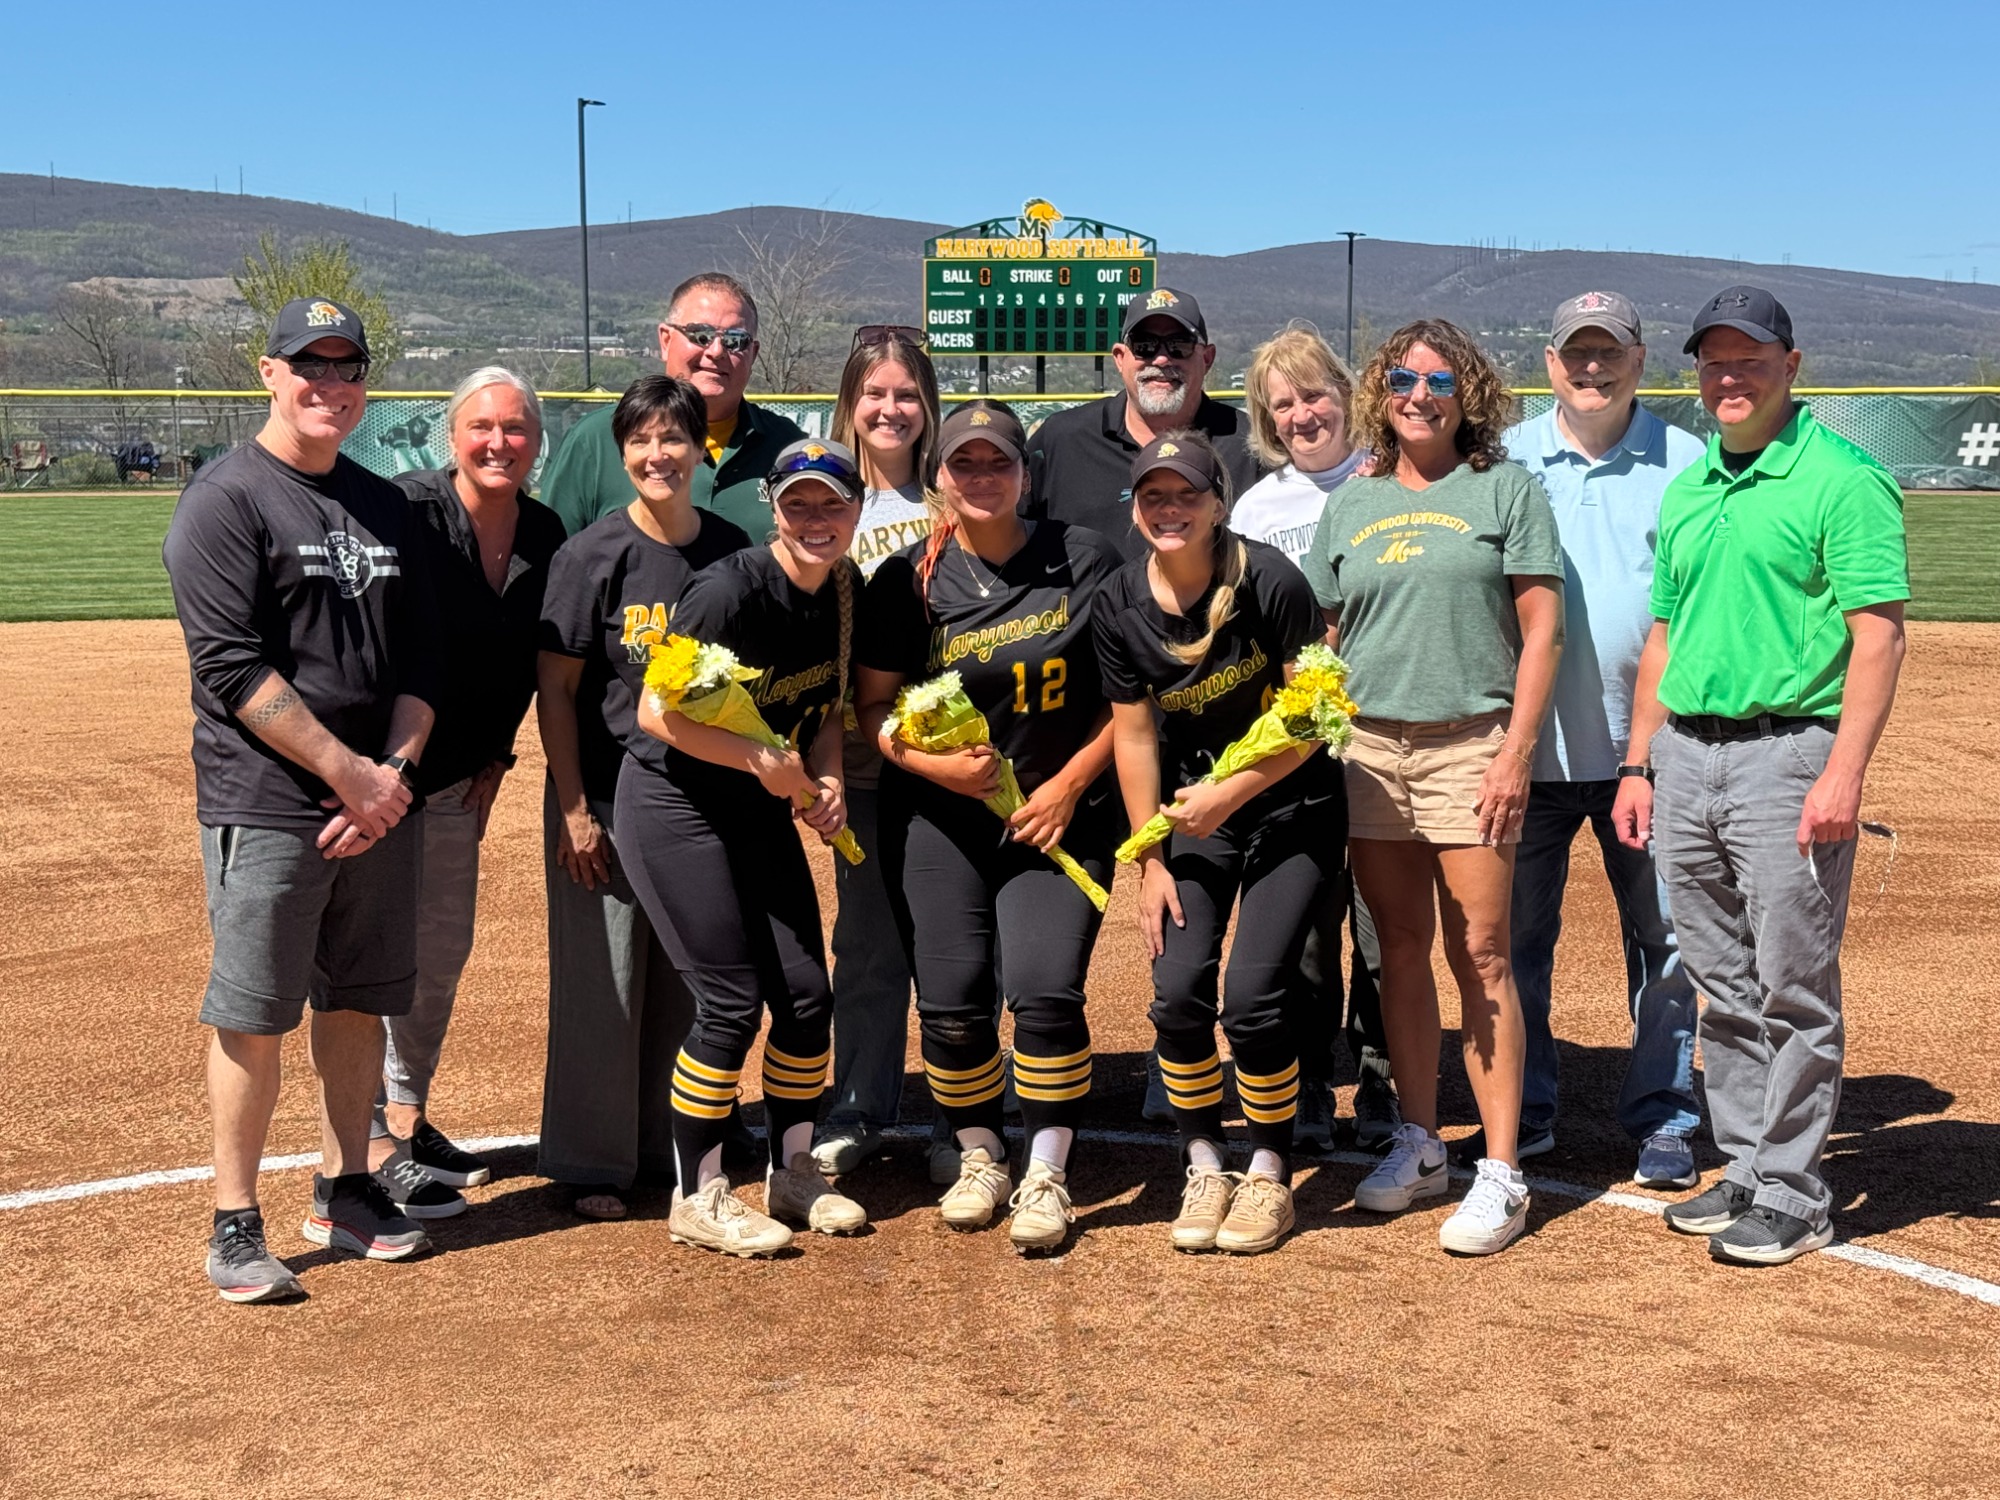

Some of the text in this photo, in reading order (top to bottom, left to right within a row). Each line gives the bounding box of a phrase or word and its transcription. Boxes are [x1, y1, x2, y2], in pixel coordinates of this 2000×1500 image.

[936, 238, 1144, 258] MARYWOOD SOFTBALL
[942, 269, 973, 283] BALL
[1010, 269, 1053, 283] STRIKE
[1097, 269, 1123, 283] OUT
[928, 309, 972, 324] GUEST
[978, 293, 985, 305] 1
[996, 293, 1005, 305] 2
[1015, 293, 1023, 305] 3
[1038, 293, 1046, 305] 4
[1056, 293, 1065, 305] 5
[1075, 293, 1084, 305] 6
[1098, 293, 1106, 305] 7
[1117, 293, 1138, 306] RU
[848, 518, 931, 565] ARYW
[1350, 511, 1473, 548] MARYWOOD UNIVERSITY
[1376, 539, 1425, 564] Mom
[620, 602, 678, 645] PA
[926, 595, 1070, 673] Marywood
[1012, 657, 1067, 713] 12
[1147, 638, 1268, 715] arywood
